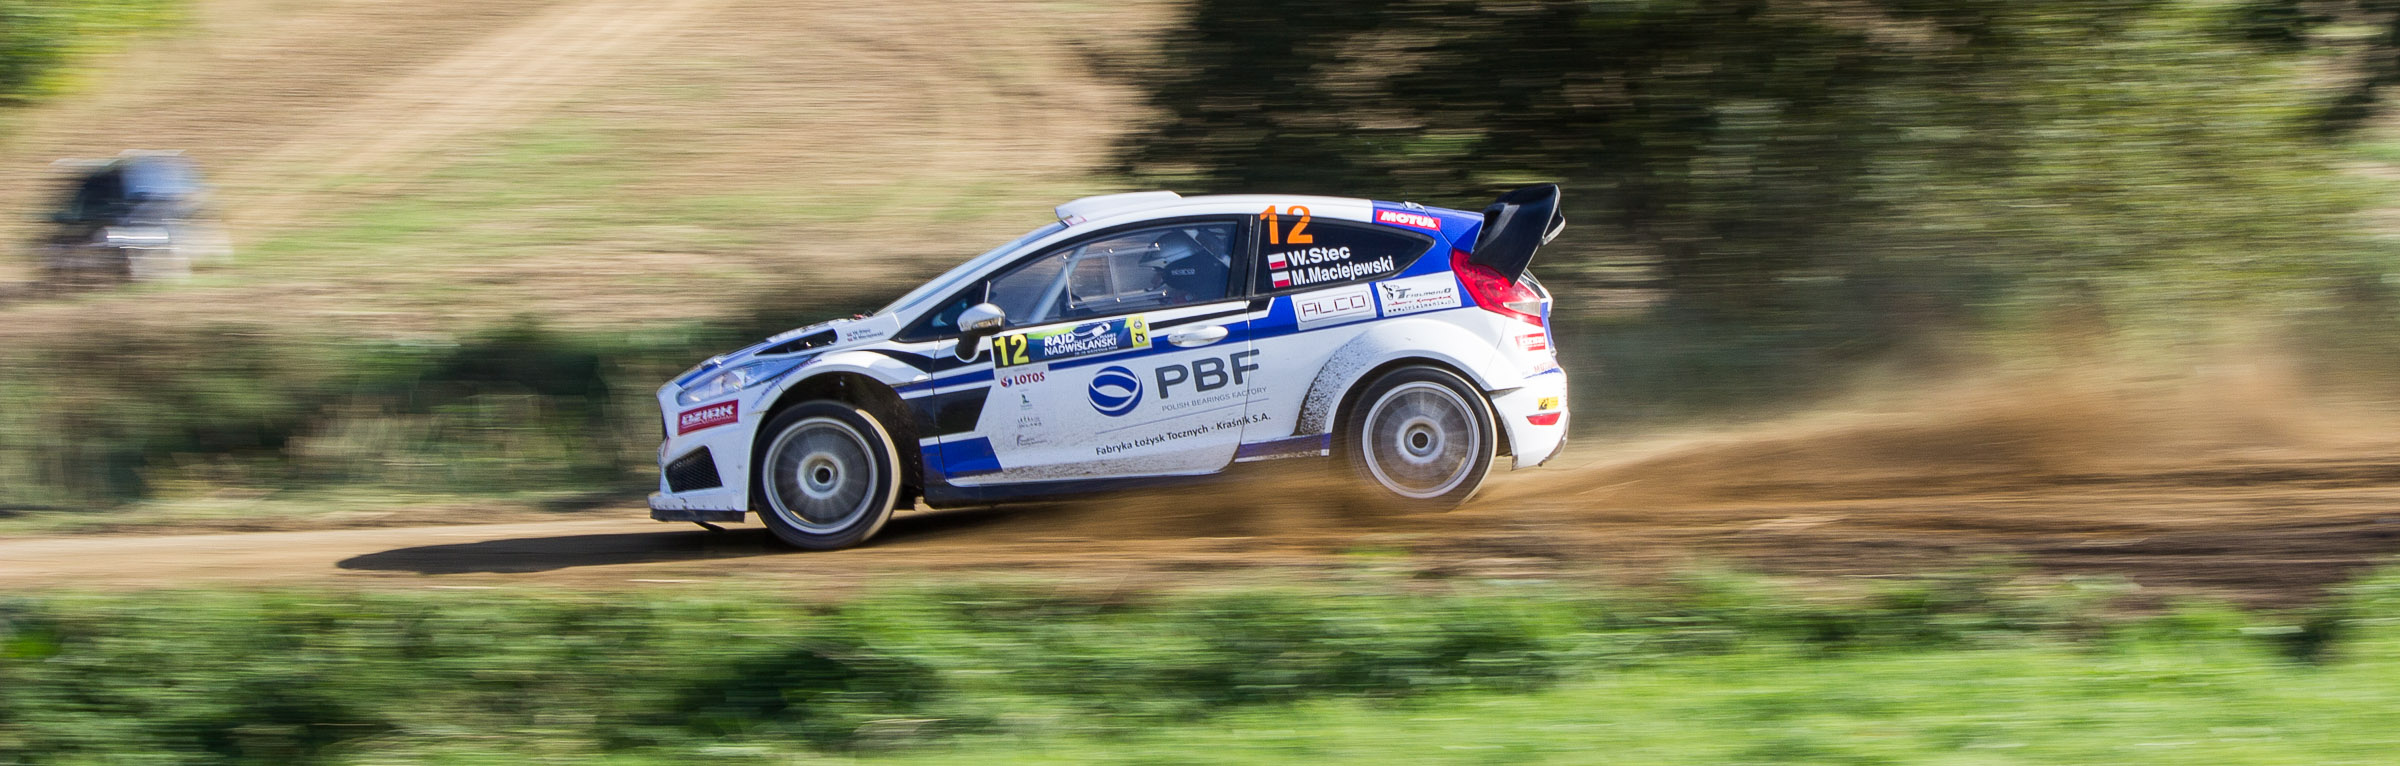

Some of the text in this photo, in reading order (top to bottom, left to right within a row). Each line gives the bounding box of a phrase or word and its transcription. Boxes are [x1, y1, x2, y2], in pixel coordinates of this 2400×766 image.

[1259, 205, 1313, 245] 12
[1380, 211, 1437, 228] MOTUL
[1287, 246, 1351, 266] W.Stec
[1292, 255, 1395, 286] M.Maciejewski
[1302, 294, 1366, 317] ALCO
[994, 334, 1030, 366] 12
[1044, 333, 1075, 347] RAJD
[1014, 371, 1045, 385] LOTOS
[1155, 349, 1260, 400] PBF
[1162, 386, 1267, 412] POLISH BEARINGS FACTORY
[1096, 442, 1133, 456] Fabryka
[1134, 434, 1166, 448] Łożysk
[1166, 424, 1209, 441] Tocznych
[1216, 415, 1251, 431] Kraśnik
[1252, 412, 1272, 423] S.A.
